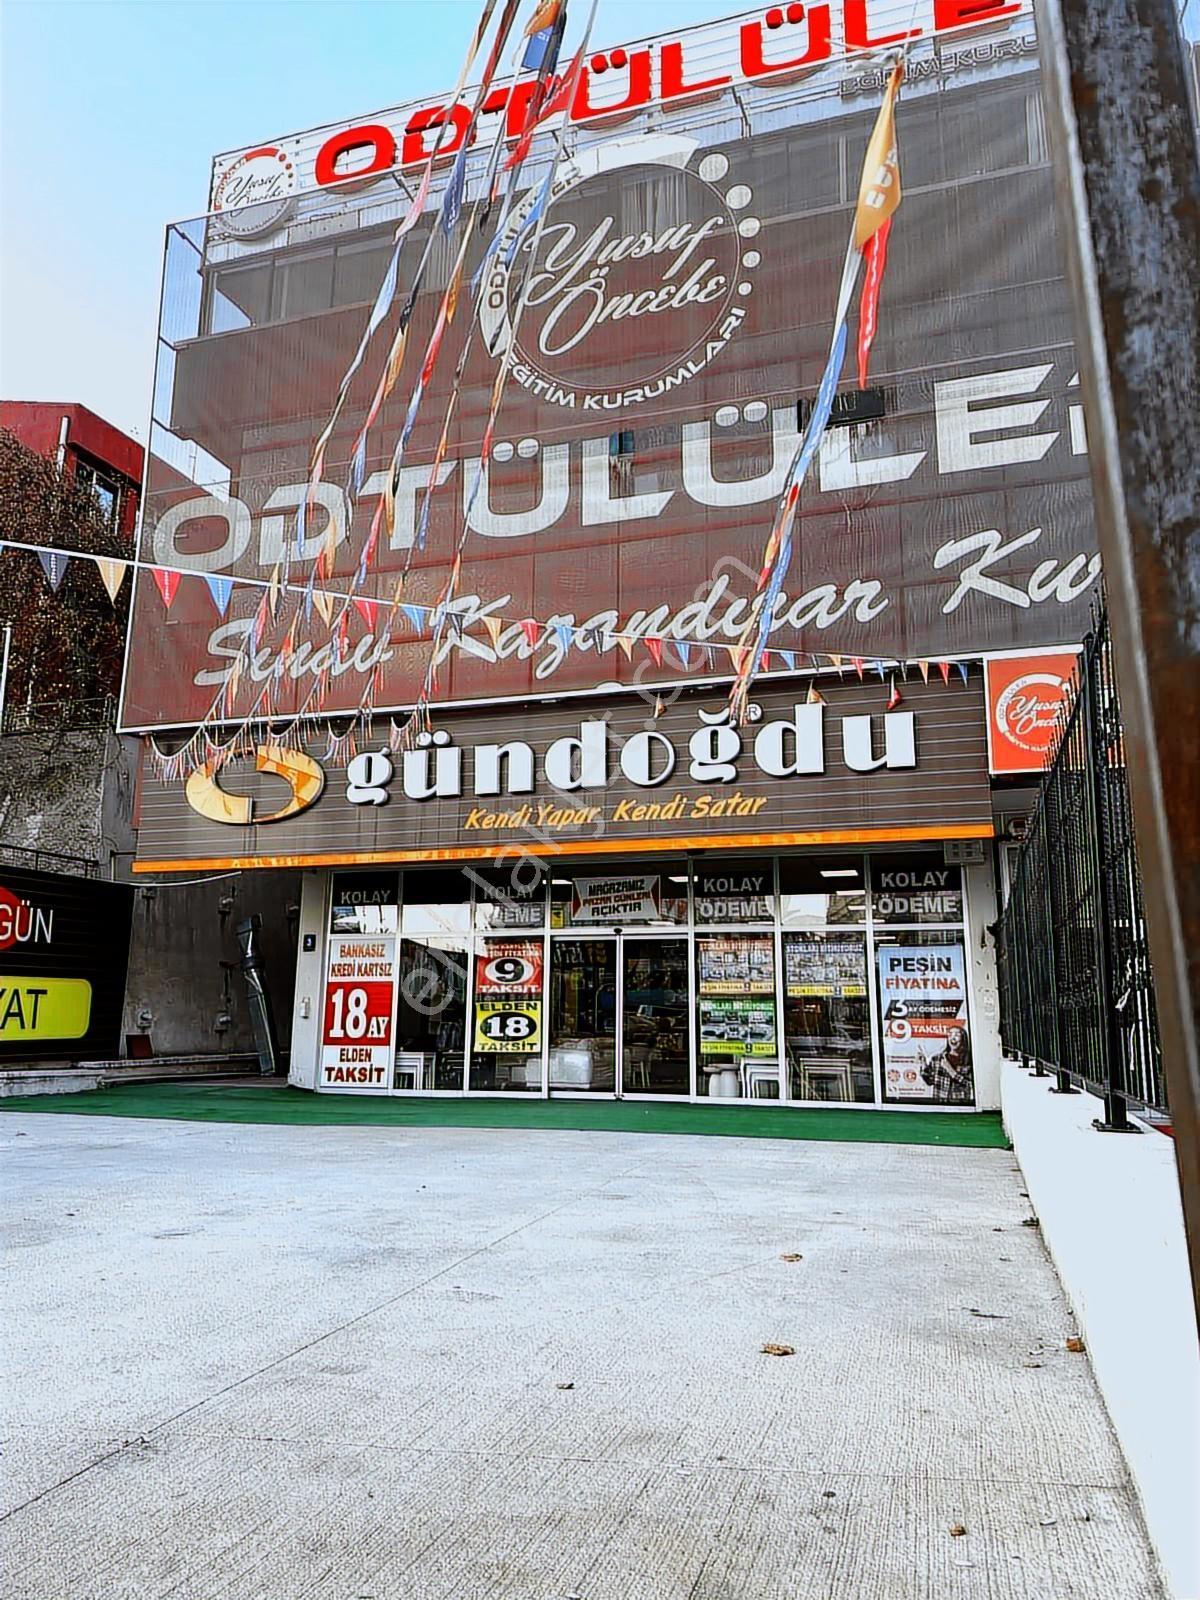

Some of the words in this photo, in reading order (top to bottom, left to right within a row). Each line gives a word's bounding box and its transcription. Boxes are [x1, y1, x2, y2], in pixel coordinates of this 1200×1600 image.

[521, 216, 725, 306] Yusuf
[539, 258, 728, 356] Öncebe
[501, 353, 577, 398] EĞİTİM
[583, 306, 747, 410] KURUMLARI
[153, 361, 1088, 572] ODTÜLÜLE
[346, 702, 917, 805] gündoğdu
[465, 804, 532, 831] Kendi
[535, 803, 601, 832] Yapar
[613, 794, 686, 822] Kendi
[690, 790, 768, 820] Satar
[703, 877, 763, 892] KOLAY
[881, 871, 949, 888] KOLAY
[341, 890, 391, 905] KOLAY
[701, 896, 773, 918] ÖDEME
[878, 894, 958, 915] ÖDEME
[591, 902, 642, 918] AÇIKTIR
[339, 943, 386, 959] BANKASIZ
[331, 959, 356, 977] KREDİ
[357, 963, 393, 977] KARTSIZ
[495, 958, 525, 983] 9
[889, 953, 953, 976] PEŞİN
[479, 984, 540, 994] TAKSİT
[886, 975, 961, 990] FİYATINA
[329, 988, 368, 1039] 18
[367, 1016, 389, 1038] AY
[480, 1002, 538, 1012] ELDEN
[890, 997, 908, 1018] 3
[486, 1016, 531, 1037] 18
[891, 1019, 912, 1043] 9
[912, 1023, 948, 1034] TAKSİT
[339, 1047, 372, 1063] ELDEN
[479, 1041, 537, 1052] TAKSİT
[325, 1065, 386, 1083] TAKSİT
